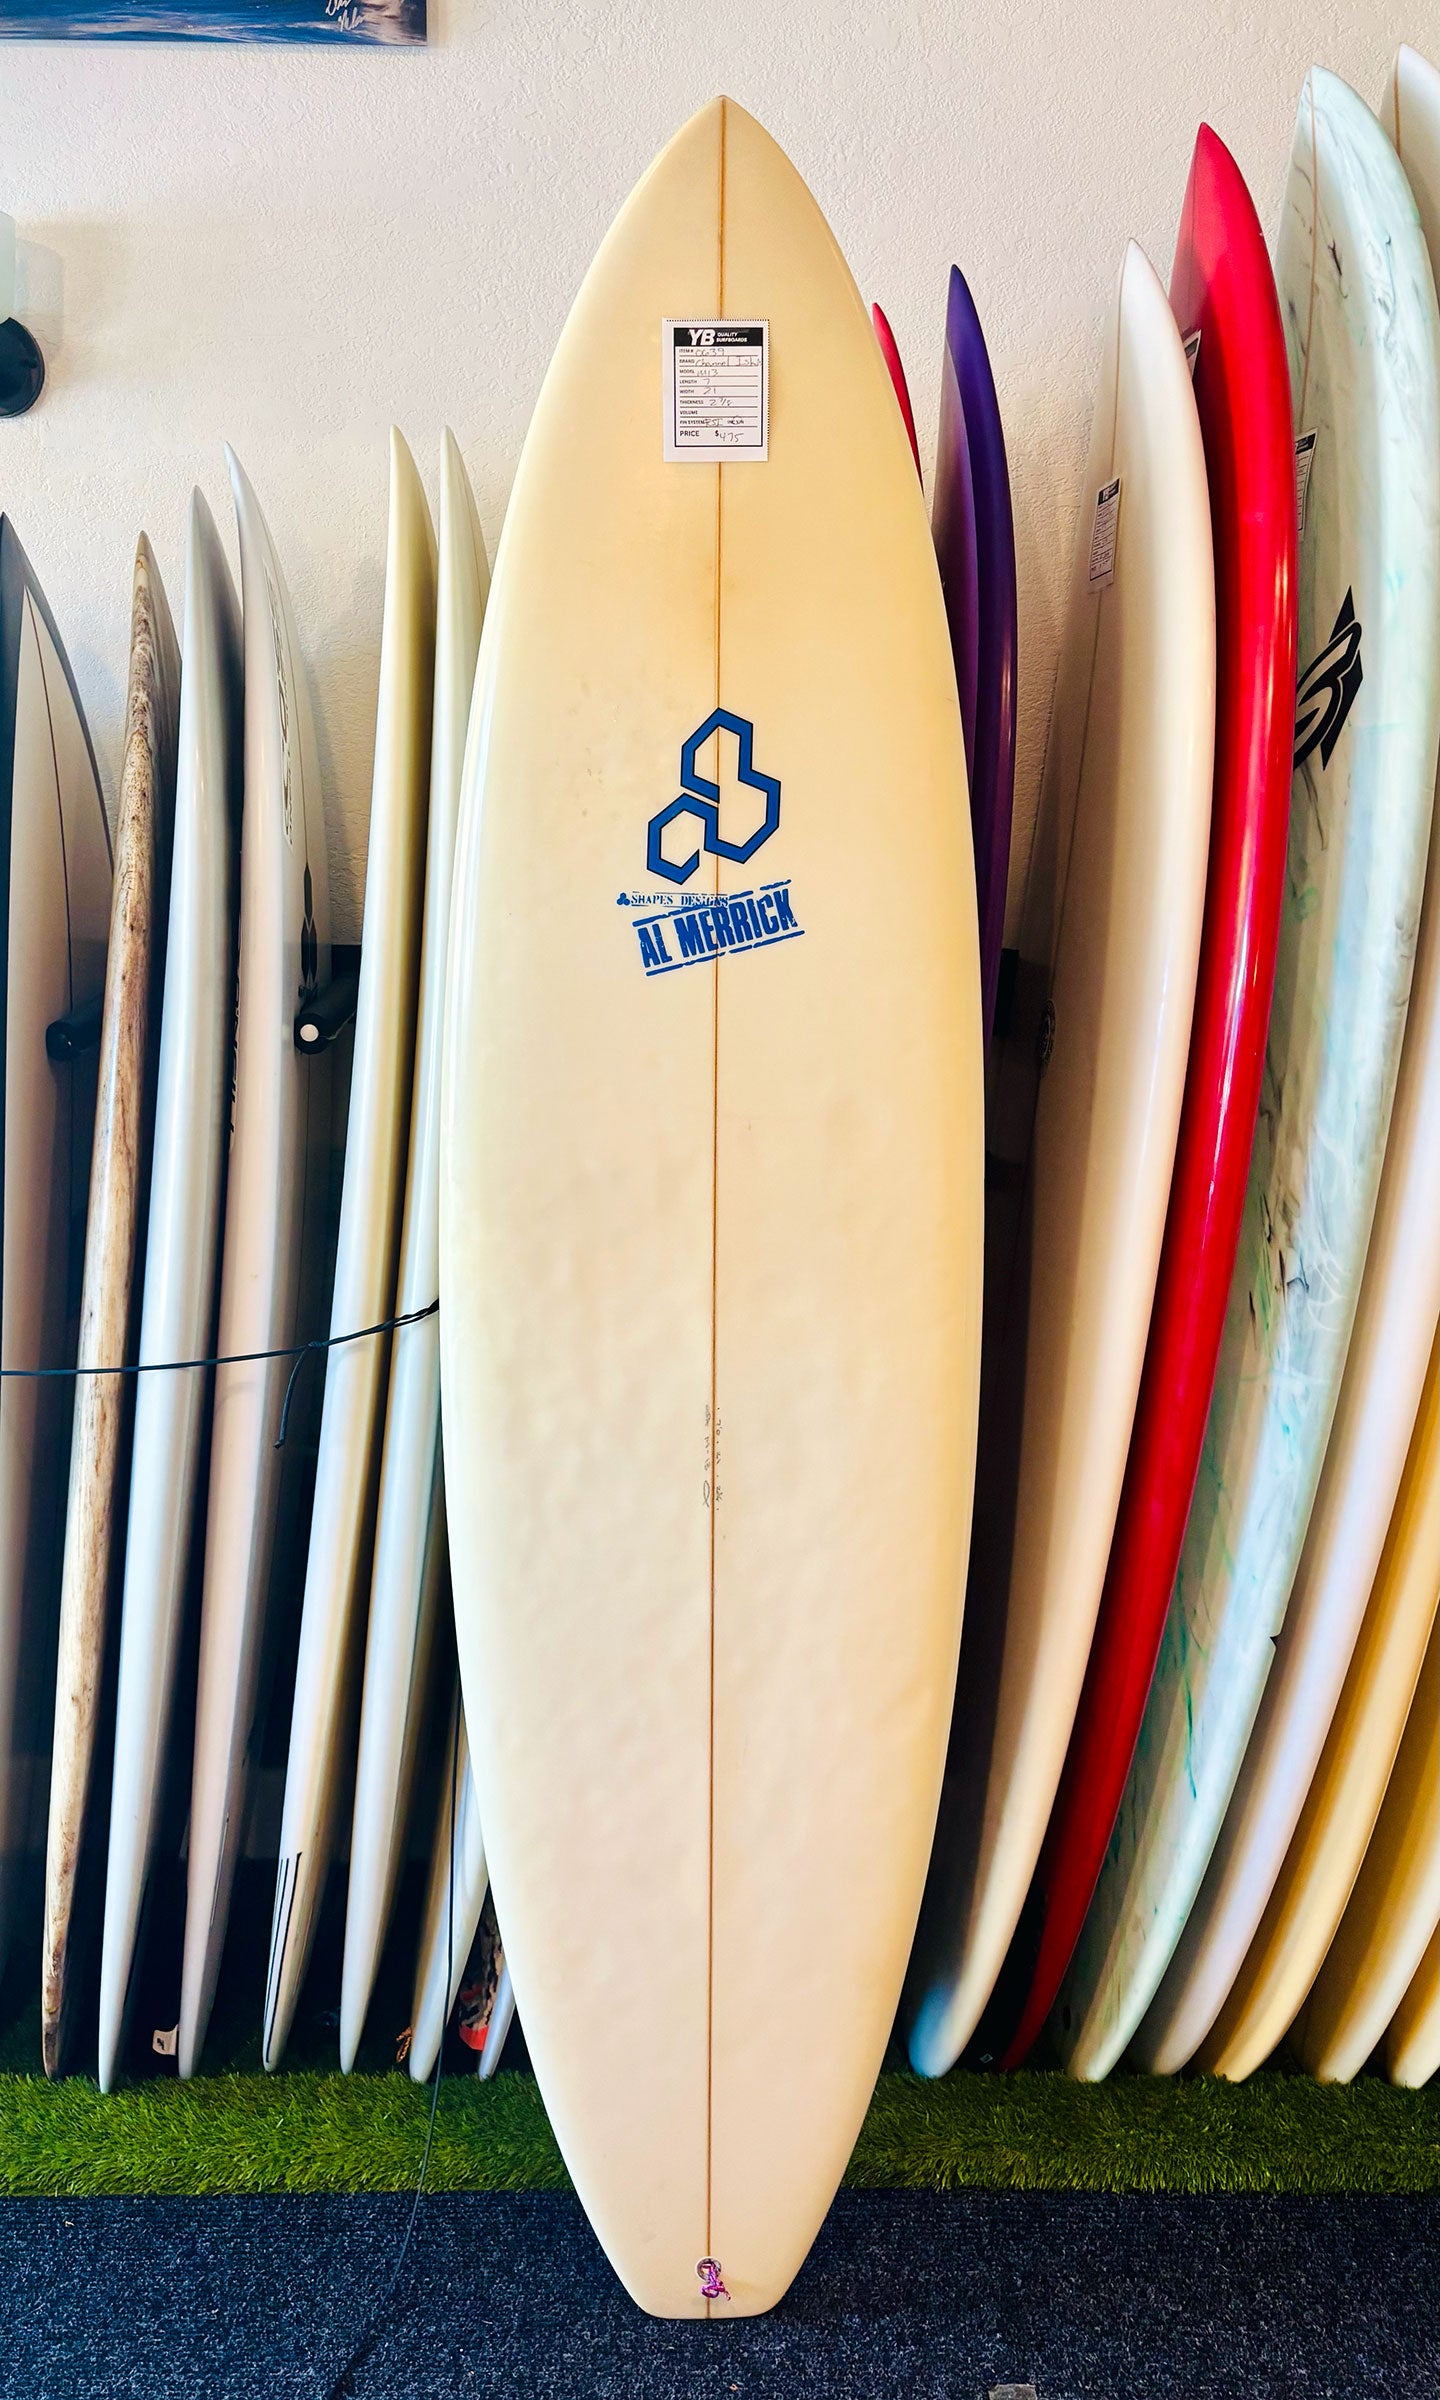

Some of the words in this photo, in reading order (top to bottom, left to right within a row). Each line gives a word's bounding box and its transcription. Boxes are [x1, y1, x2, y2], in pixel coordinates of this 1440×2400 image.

[689, 329, 716, 346] YB
[631, 894, 674, 905] SHAPES
[681, 895, 729, 907] DESIGNS
[637, 923, 673, 968] AL
[673, 888, 798, 958] MERRICK
